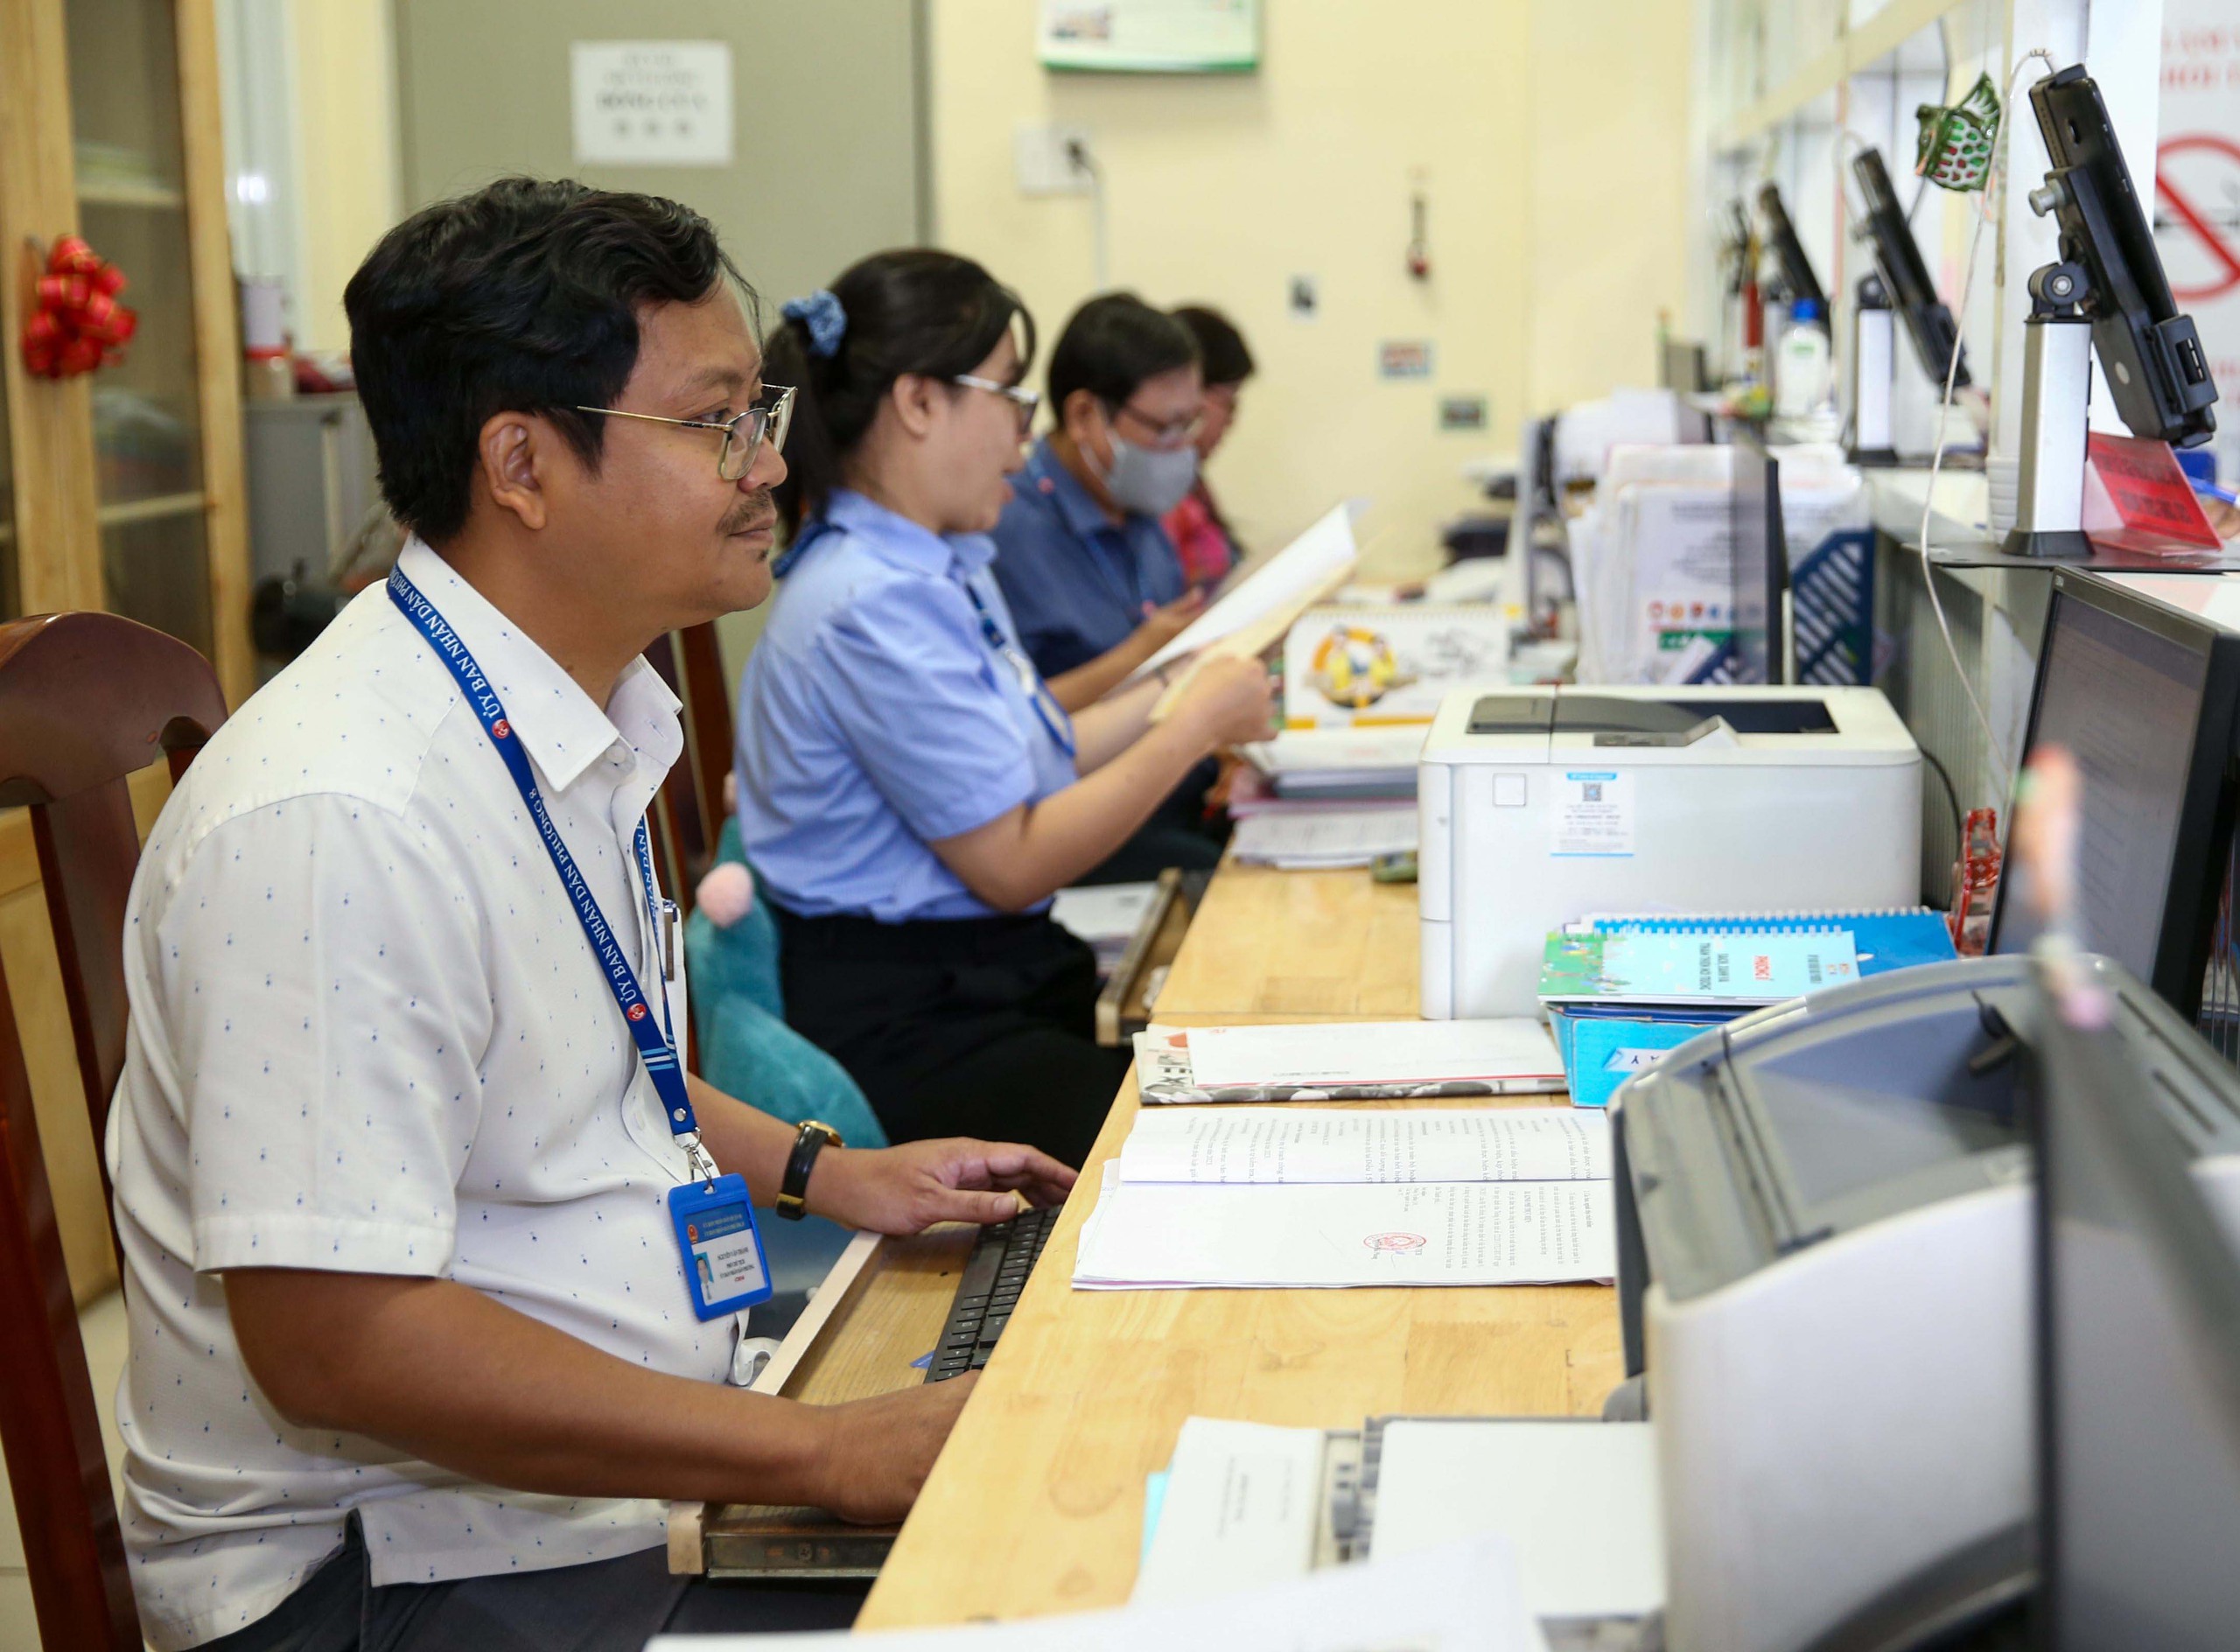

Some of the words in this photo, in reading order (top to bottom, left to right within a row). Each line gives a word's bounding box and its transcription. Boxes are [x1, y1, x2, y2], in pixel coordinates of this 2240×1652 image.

[405, 592, 434, 620] DÂN
[425, 615, 465, 658] NHÂN
[456, 656, 487, 692] BAN
[528, 788, 537, 799] 8
[534, 800, 570, 865] PHƯỜNG
[564, 864, 587, 900] DÂN
[581, 900, 612, 947] NHÂN
[602, 945, 626, 976] BAN
